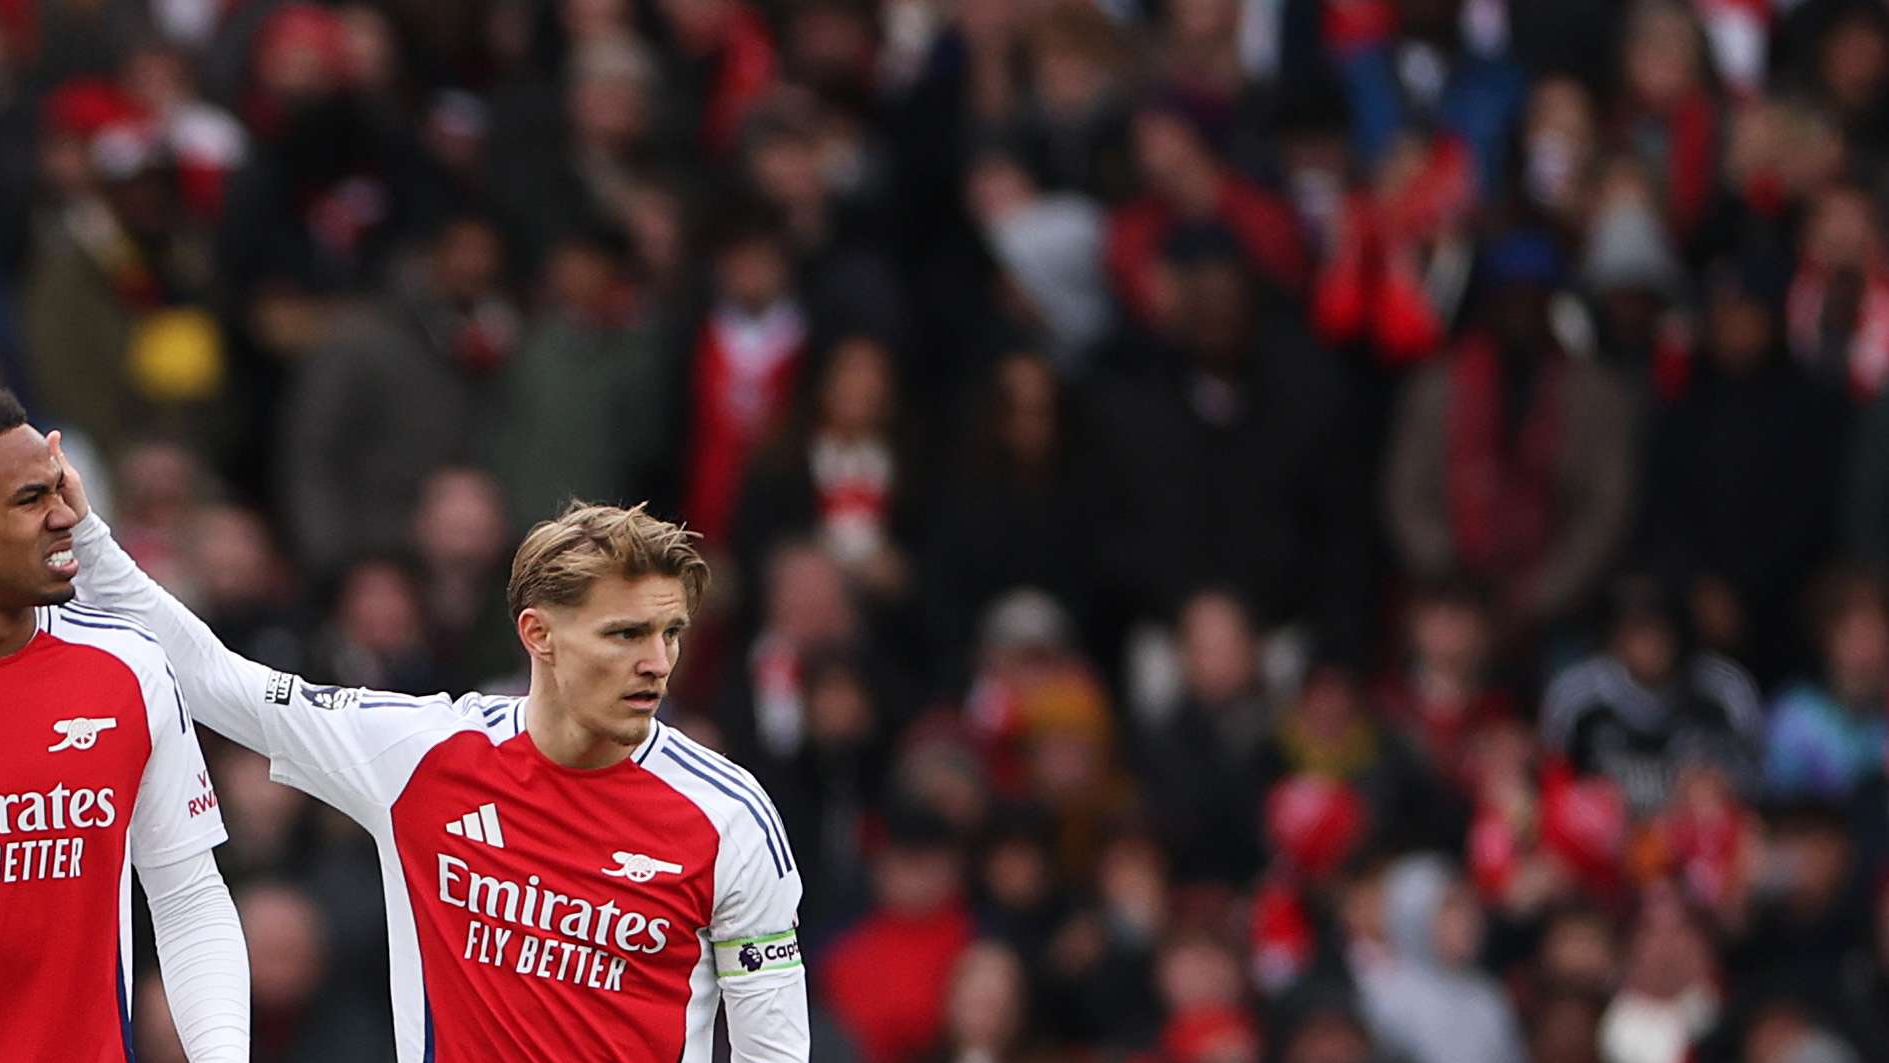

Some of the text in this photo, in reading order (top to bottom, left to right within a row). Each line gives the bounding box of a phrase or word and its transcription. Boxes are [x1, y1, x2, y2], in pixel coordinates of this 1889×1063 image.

[188, 790, 216, 818] RW
[197, 770, 208, 788] V
[437, 853, 671, 954] Emirates
[464, 920, 627, 992] FLY BETTER
